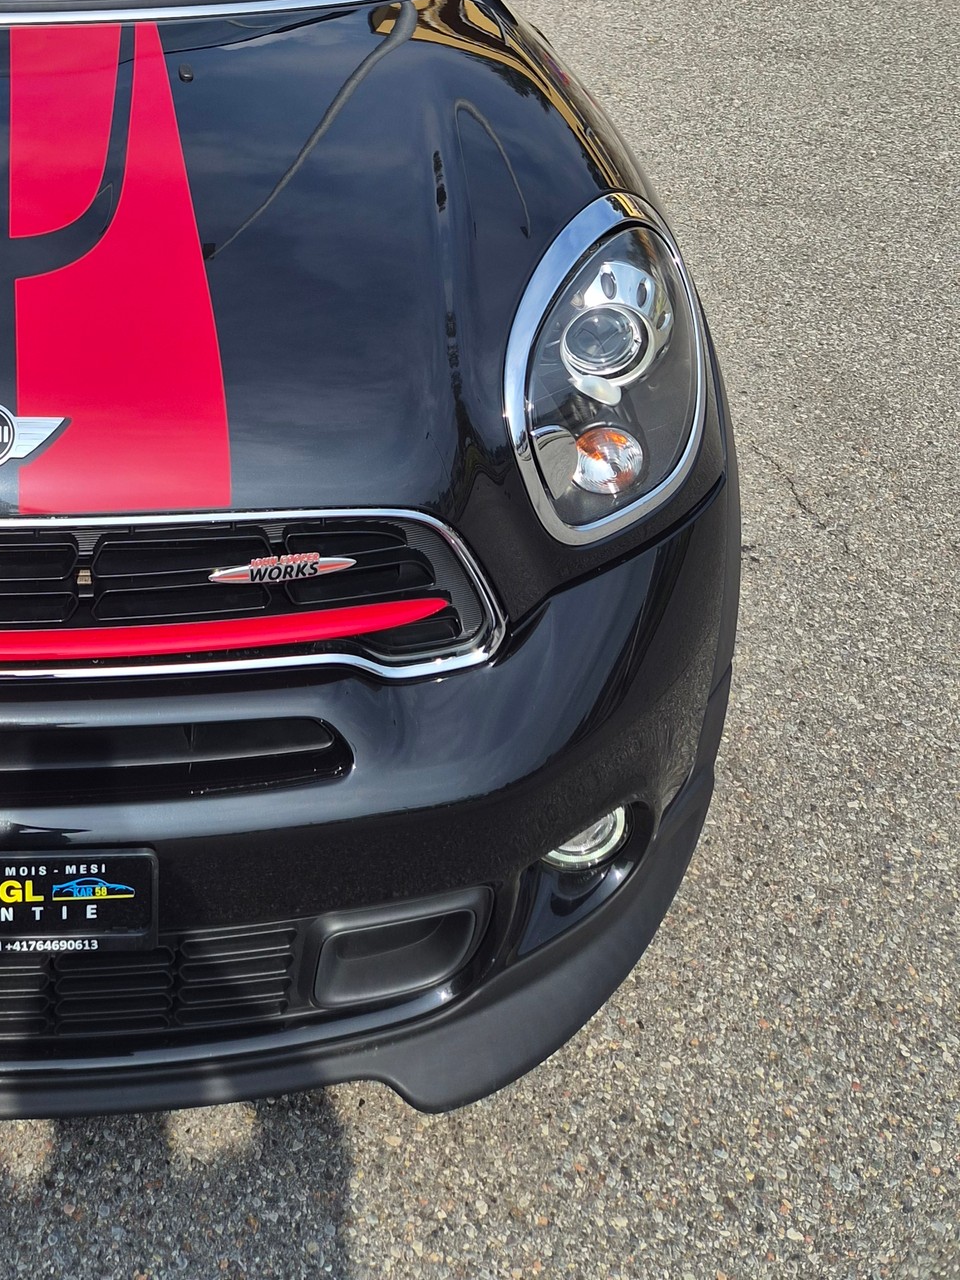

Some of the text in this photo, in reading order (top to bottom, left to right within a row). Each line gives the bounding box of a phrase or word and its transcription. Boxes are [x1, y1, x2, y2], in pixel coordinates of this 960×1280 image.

[250, 561, 319, 582] WORKS
[5, 865, 47, 877] MOIS
[65, 863, 106, 875] MESI
[73, 886, 108, 897] KAR 58
[4, 939, 99, 952] +41764690613
